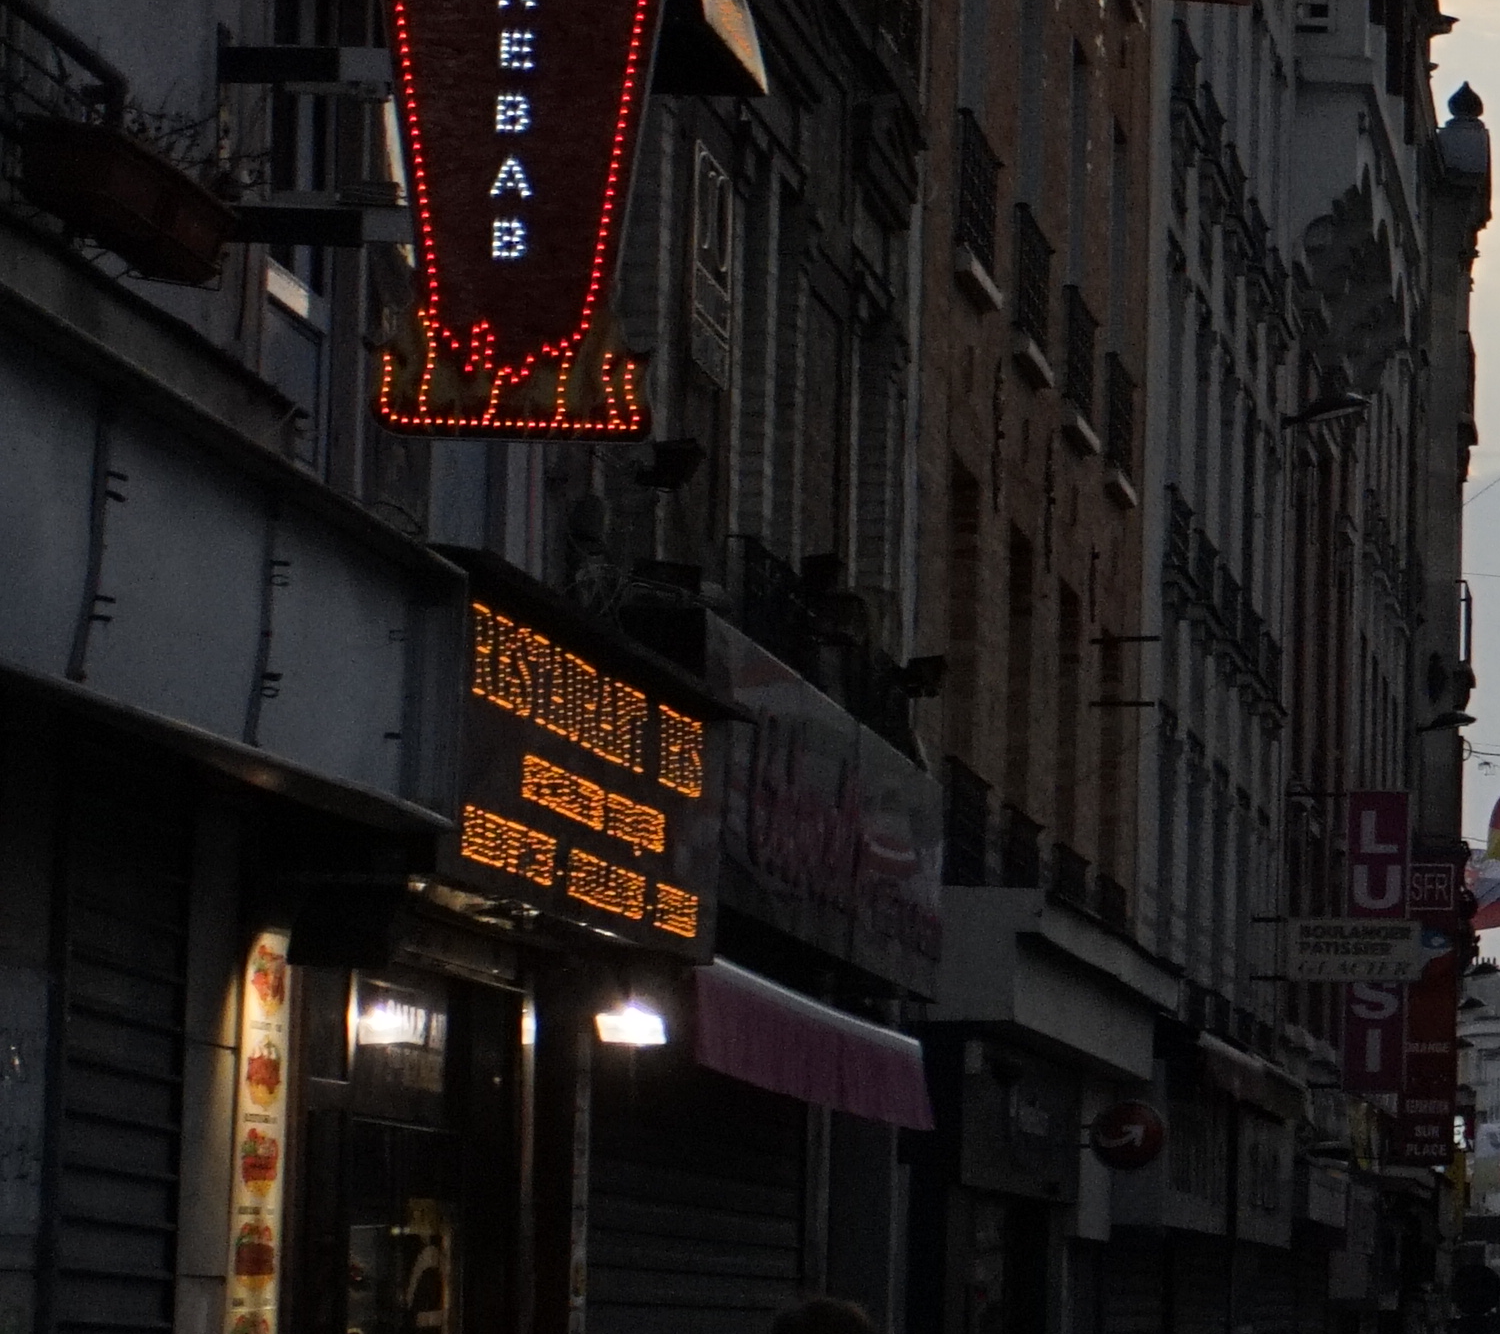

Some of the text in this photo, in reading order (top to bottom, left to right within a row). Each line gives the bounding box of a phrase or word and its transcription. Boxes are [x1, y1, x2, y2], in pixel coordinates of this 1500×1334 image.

[1412, 872, 1450, 902] SFR
[1299, 924, 1411, 940] BOULANGER
[1298, 941, 1391, 955] PATISSIER
[1406, 1143, 1447, 1157] PLACE
